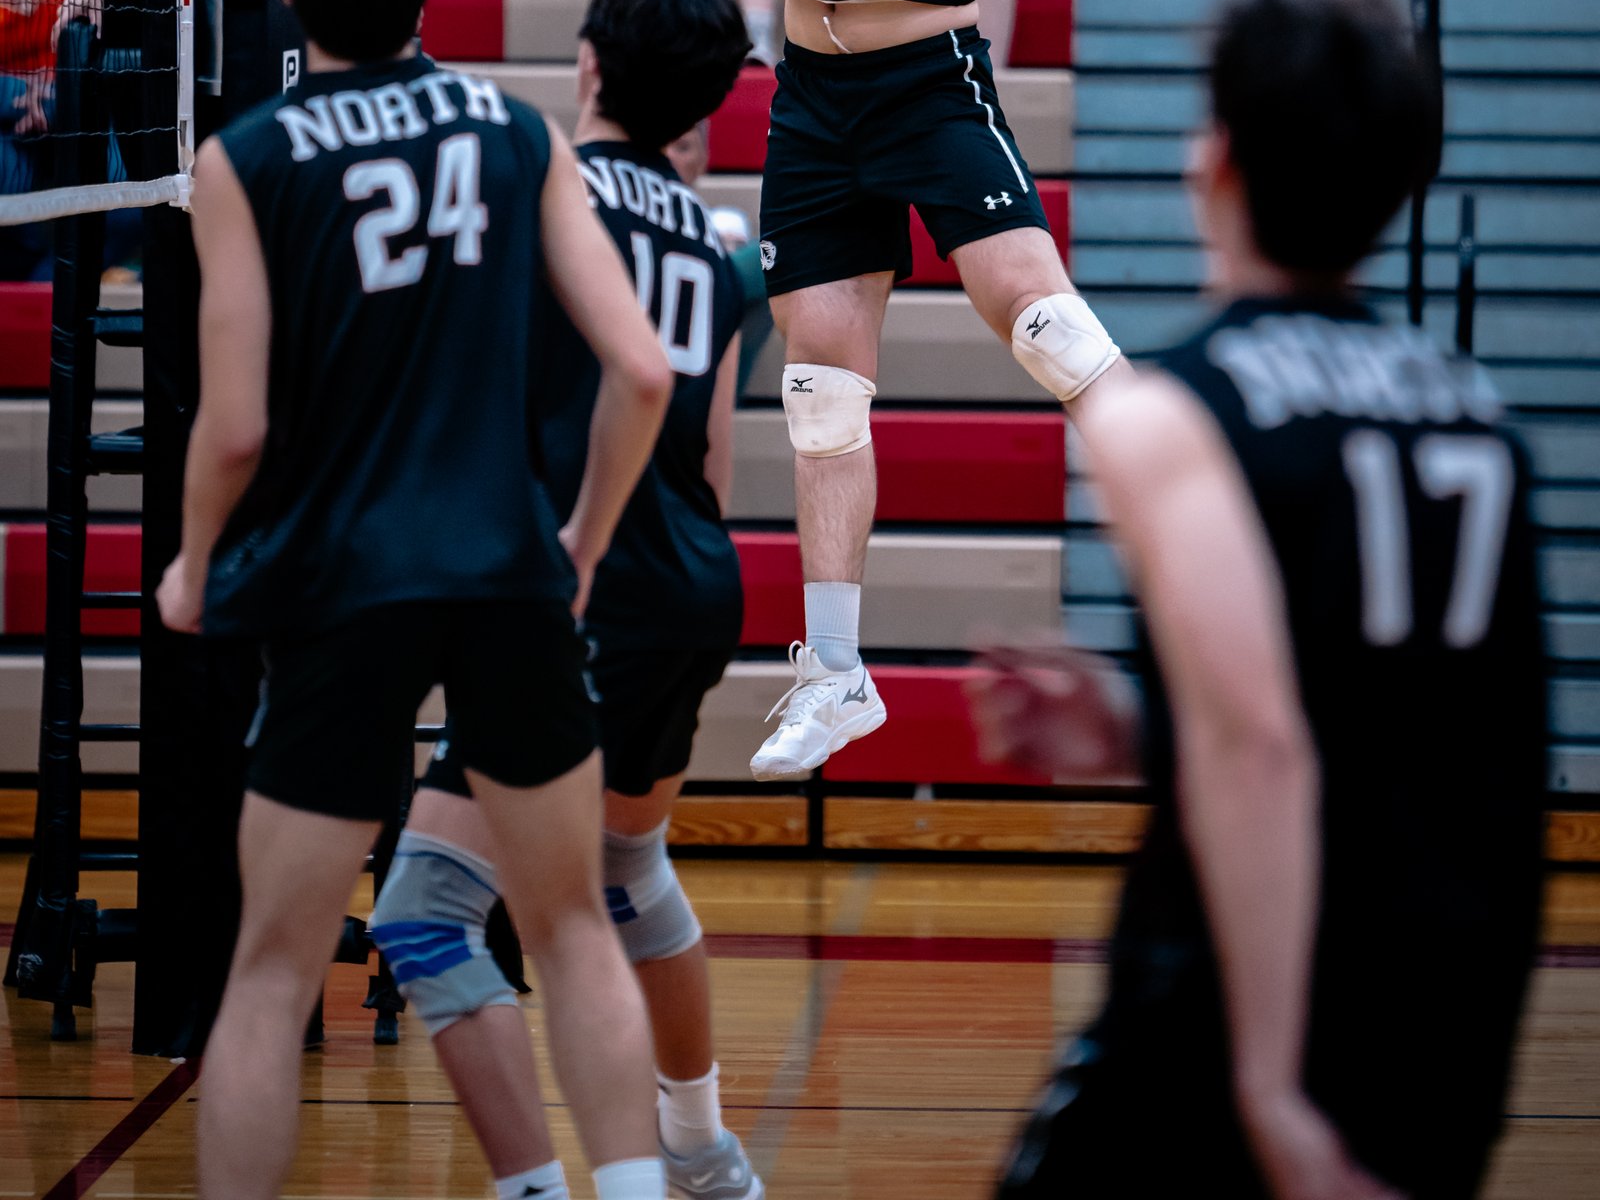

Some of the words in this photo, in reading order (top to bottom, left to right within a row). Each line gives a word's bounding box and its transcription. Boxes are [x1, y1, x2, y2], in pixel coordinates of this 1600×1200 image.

[275, 69, 512, 162] NORTH
[343, 133, 489, 293] 24
[630, 231, 715, 377] 10
[1341, 427, 1516, 649] 17
